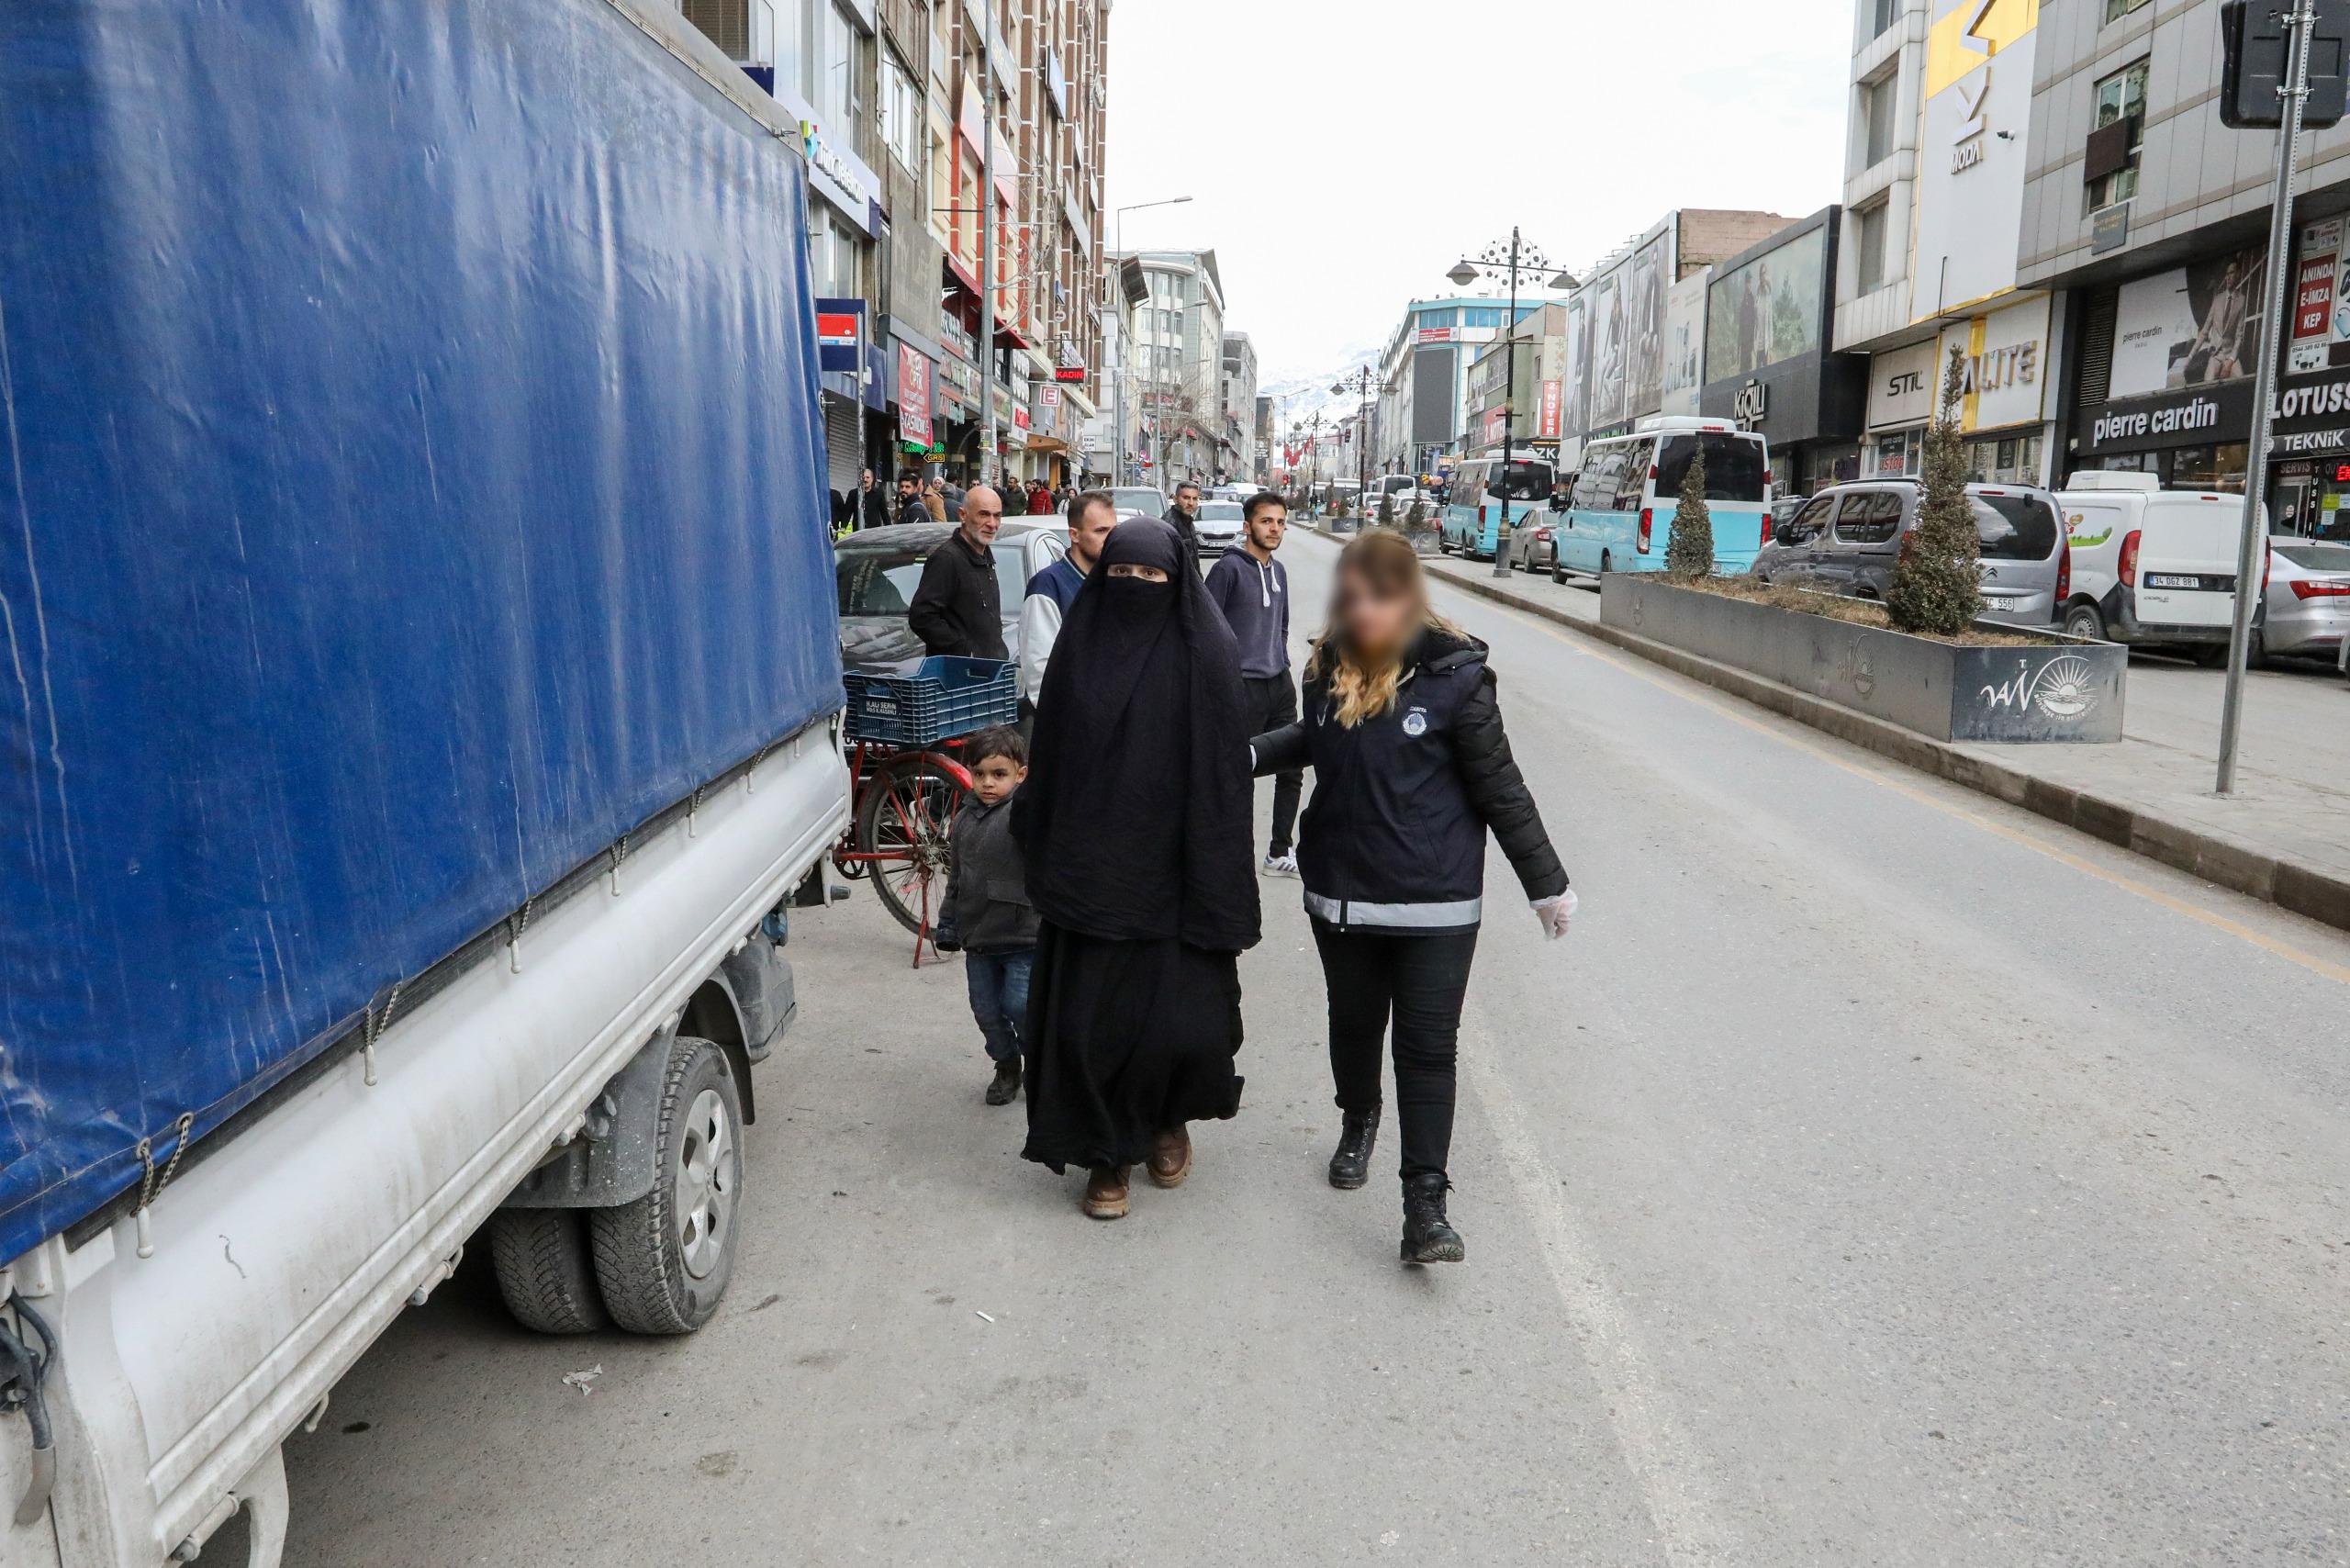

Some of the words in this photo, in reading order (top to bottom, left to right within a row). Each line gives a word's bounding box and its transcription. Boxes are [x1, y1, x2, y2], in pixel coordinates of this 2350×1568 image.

[1951, 140, 1982, 175] MODA
[2300, 262, 2334, 284] ANINDA
[2300, 286, 2330, 308] E-İMZA
[2302, 311, 2322, 330] KEP
[2122, 330, 2141, 345] pierre
[2142, 325, 2163, 337] cardin
[1546, 393, 1556, 434] NOTER
[2093, 411, 2148, 448] pierre
[2152, 398, 2219, 434] cardin
[2154, 577, 2164, 585] 34
[2182, 577, 2197, 587] 881
[1998, 598, 2014, 609] 556
